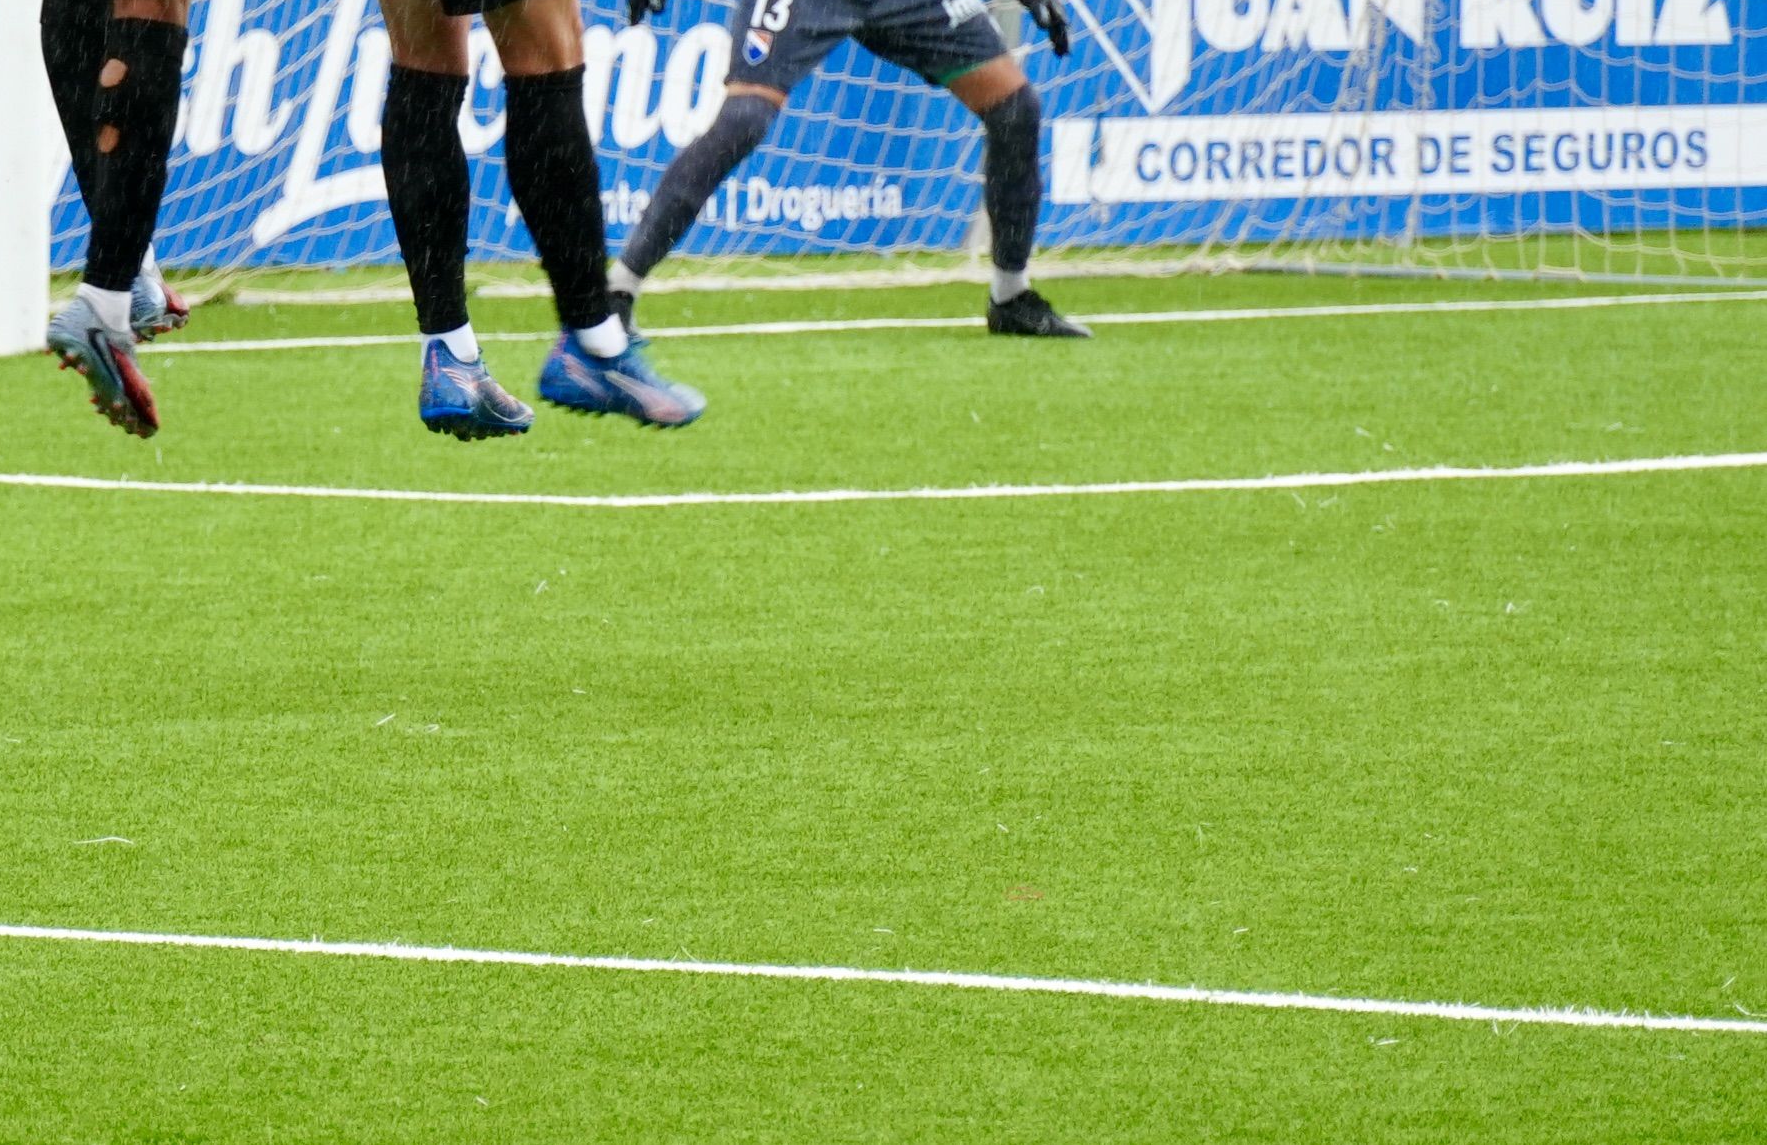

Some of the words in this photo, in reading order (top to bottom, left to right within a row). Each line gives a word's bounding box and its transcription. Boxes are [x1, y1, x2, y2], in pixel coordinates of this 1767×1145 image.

[1136, 135, 1394, 183] CORREDOR
[1416, 133, 1472, 176] DE
[1490, 128, 1709, 173] SEGUROS
[747, 174, 903, 232] Droguería
